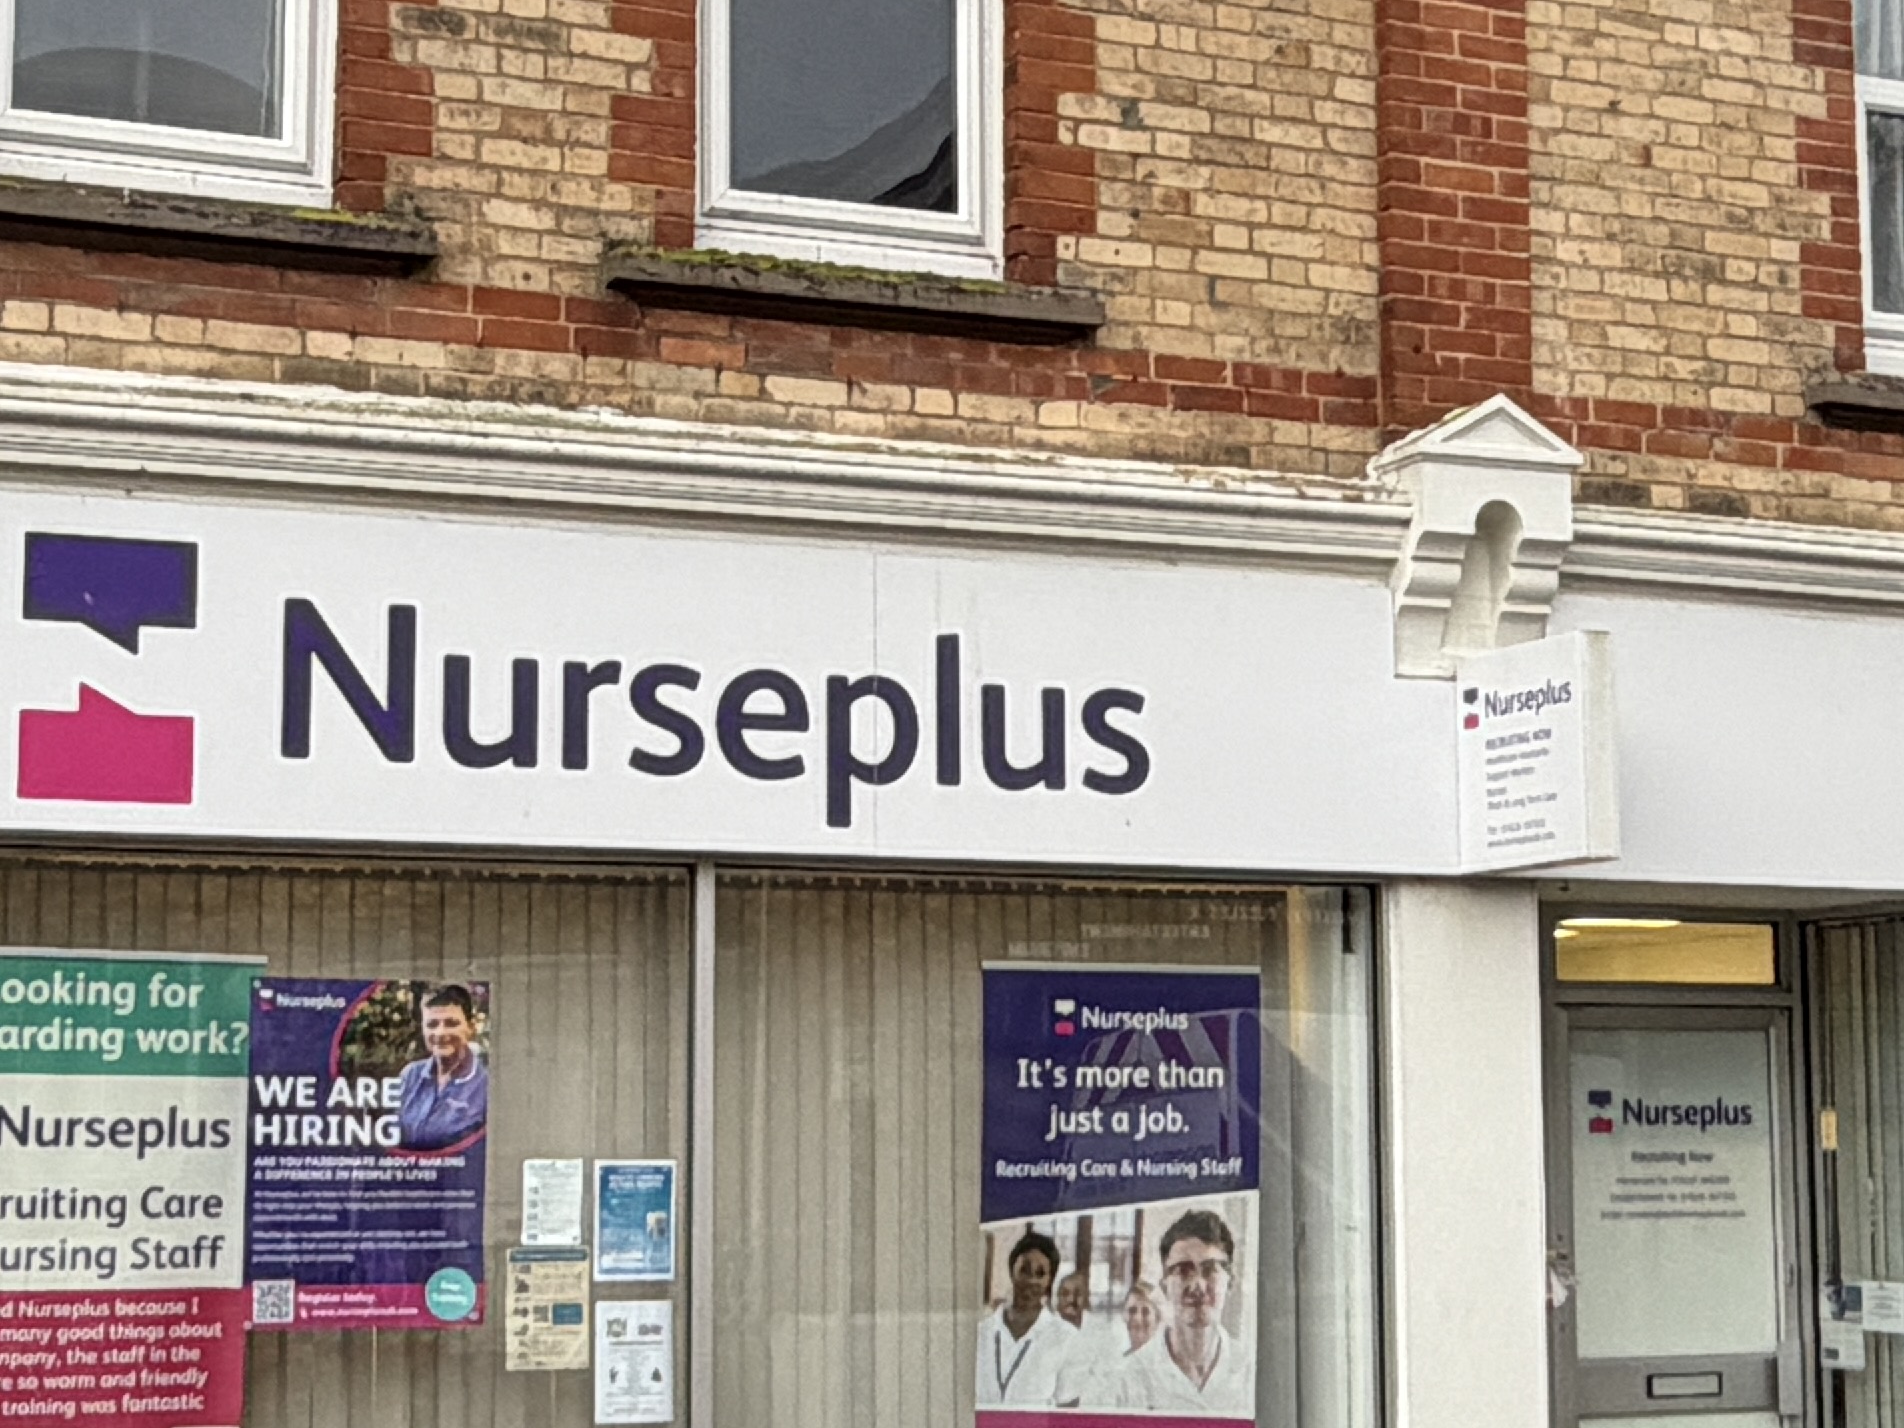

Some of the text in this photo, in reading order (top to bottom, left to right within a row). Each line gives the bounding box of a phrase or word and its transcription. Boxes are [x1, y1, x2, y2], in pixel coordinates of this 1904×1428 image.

[279, 595, 1151, 829] Nurseplus
[1485, 678, 1571, 718] Nurseplus
[148, 972, 204, 1008] for
[276, 993, 346, 1011] Nurseplus
[1082, 1006, 1188, 1033] Nurseplus
[136, 1020, 248, 1054] work?
[1017, 1059, 1224, 1089] It's more than
[254, 1074, 402, 1108] WE ARE
[254, 1113, 401, 1147] HIRING
[1046, 1103, 1190, 1141] just a job.
[1623, 1096, 1752, 1133] Nurseplus
[996, 1157, 1243, 1182] Recruiting Care & Nursing Staff
[140, 1185, 223, 1218] Care
[130, 1235, 225, 1269] Staff
[18, 1298, 110, 1321] Nurseplus
[115, 1297, 186, 1316] because
[191, 1296, 199, 1315] I
[0, 1328, 52, 1346] many
[56, 1322, 104, 1345] good
[109, 1322, 165, 1344] things
[169, 1321, 223, 1339] about
[66, 1346, 97, 1365] the
[103, 1345, 145, 1364] staff
[149, 1346, 166, 1362] in
[170, 1344, 201, 1362] the
[17, 1376, 39, 1390] so
[43, 1374, 95, 1389] warm
[100, 1370, 136, 1388] and
[140, 1367, 209, 1390] friendly
[2, 1396, 76, 1419] training
[81, 1400, 116, 1414] was
[122, 1392, 205, 1414] fantastic
